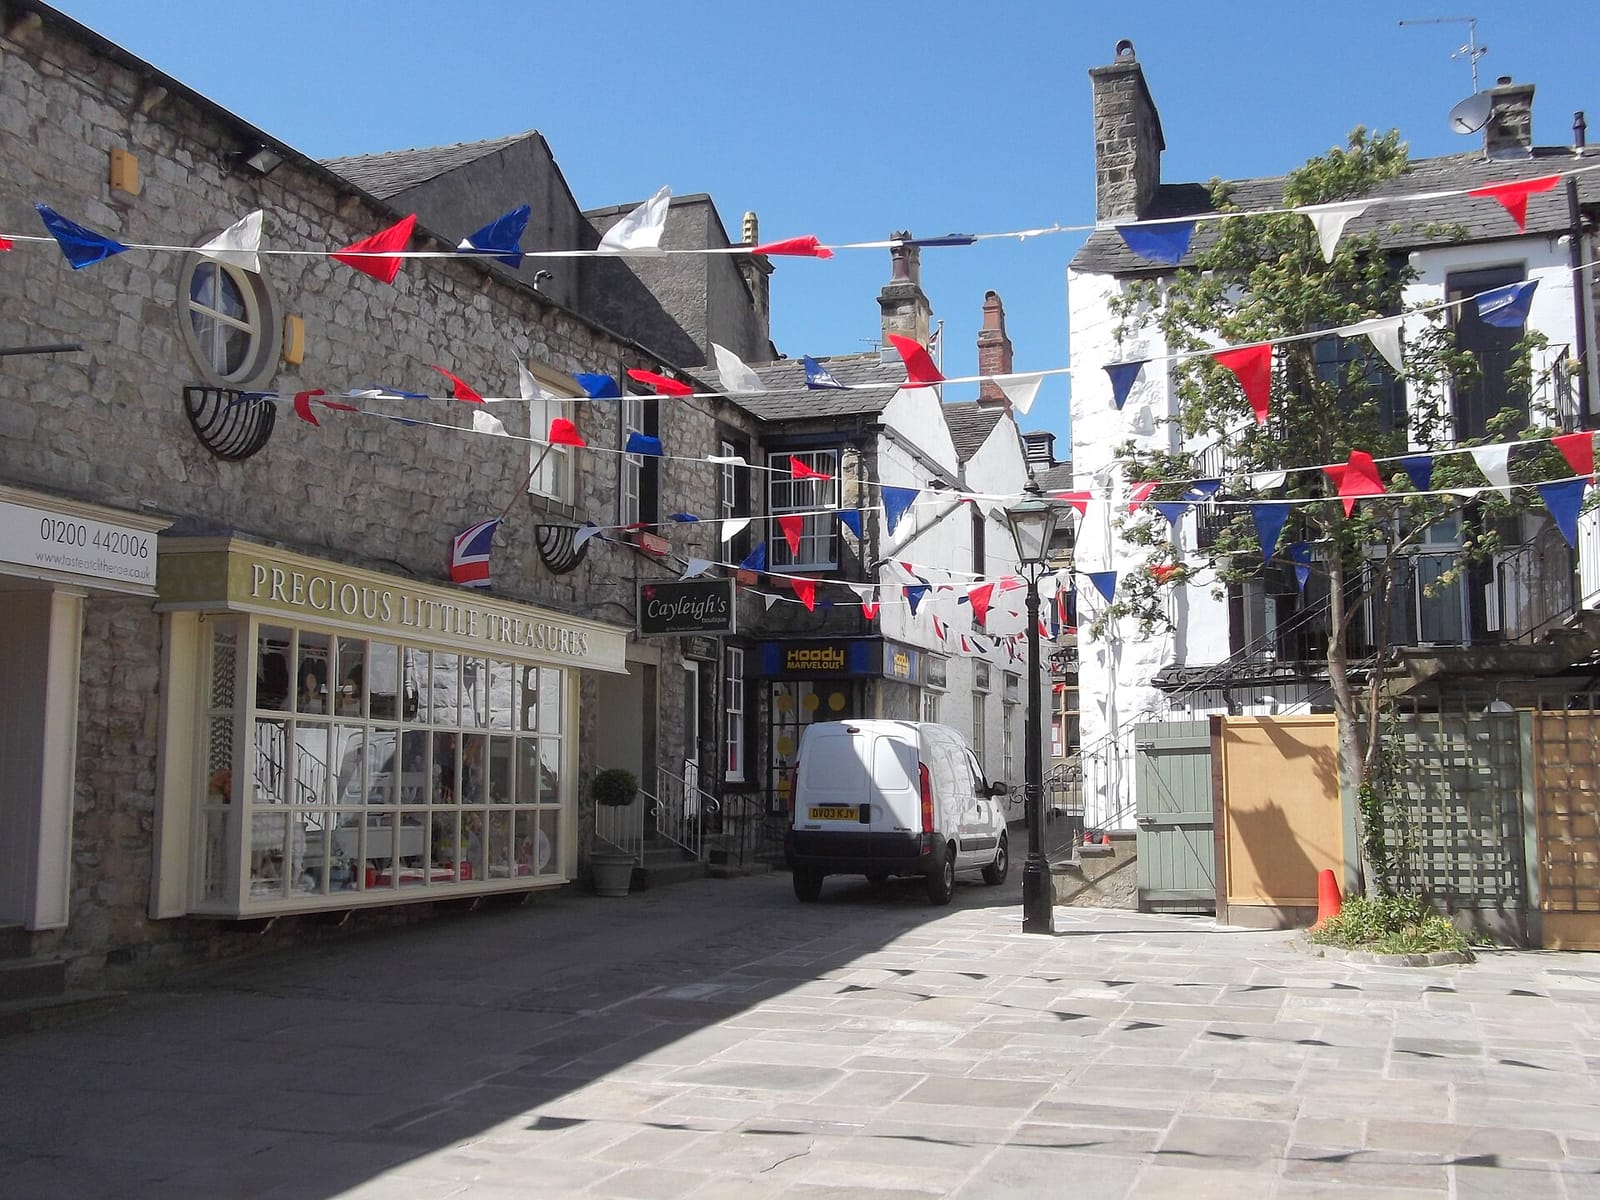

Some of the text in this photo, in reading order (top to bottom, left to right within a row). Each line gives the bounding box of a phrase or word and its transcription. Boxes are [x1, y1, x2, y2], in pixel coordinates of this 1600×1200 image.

[40, 517, 149, 559] 01200 442006
[251, 563, 590, 657] PRECIOUS LITTLE TREASURES
[647, 594, 727, 622] Cayleigh's
[786, 660, 841, 670] MARVELOUS
[836, 808, 855, 819] KJY
